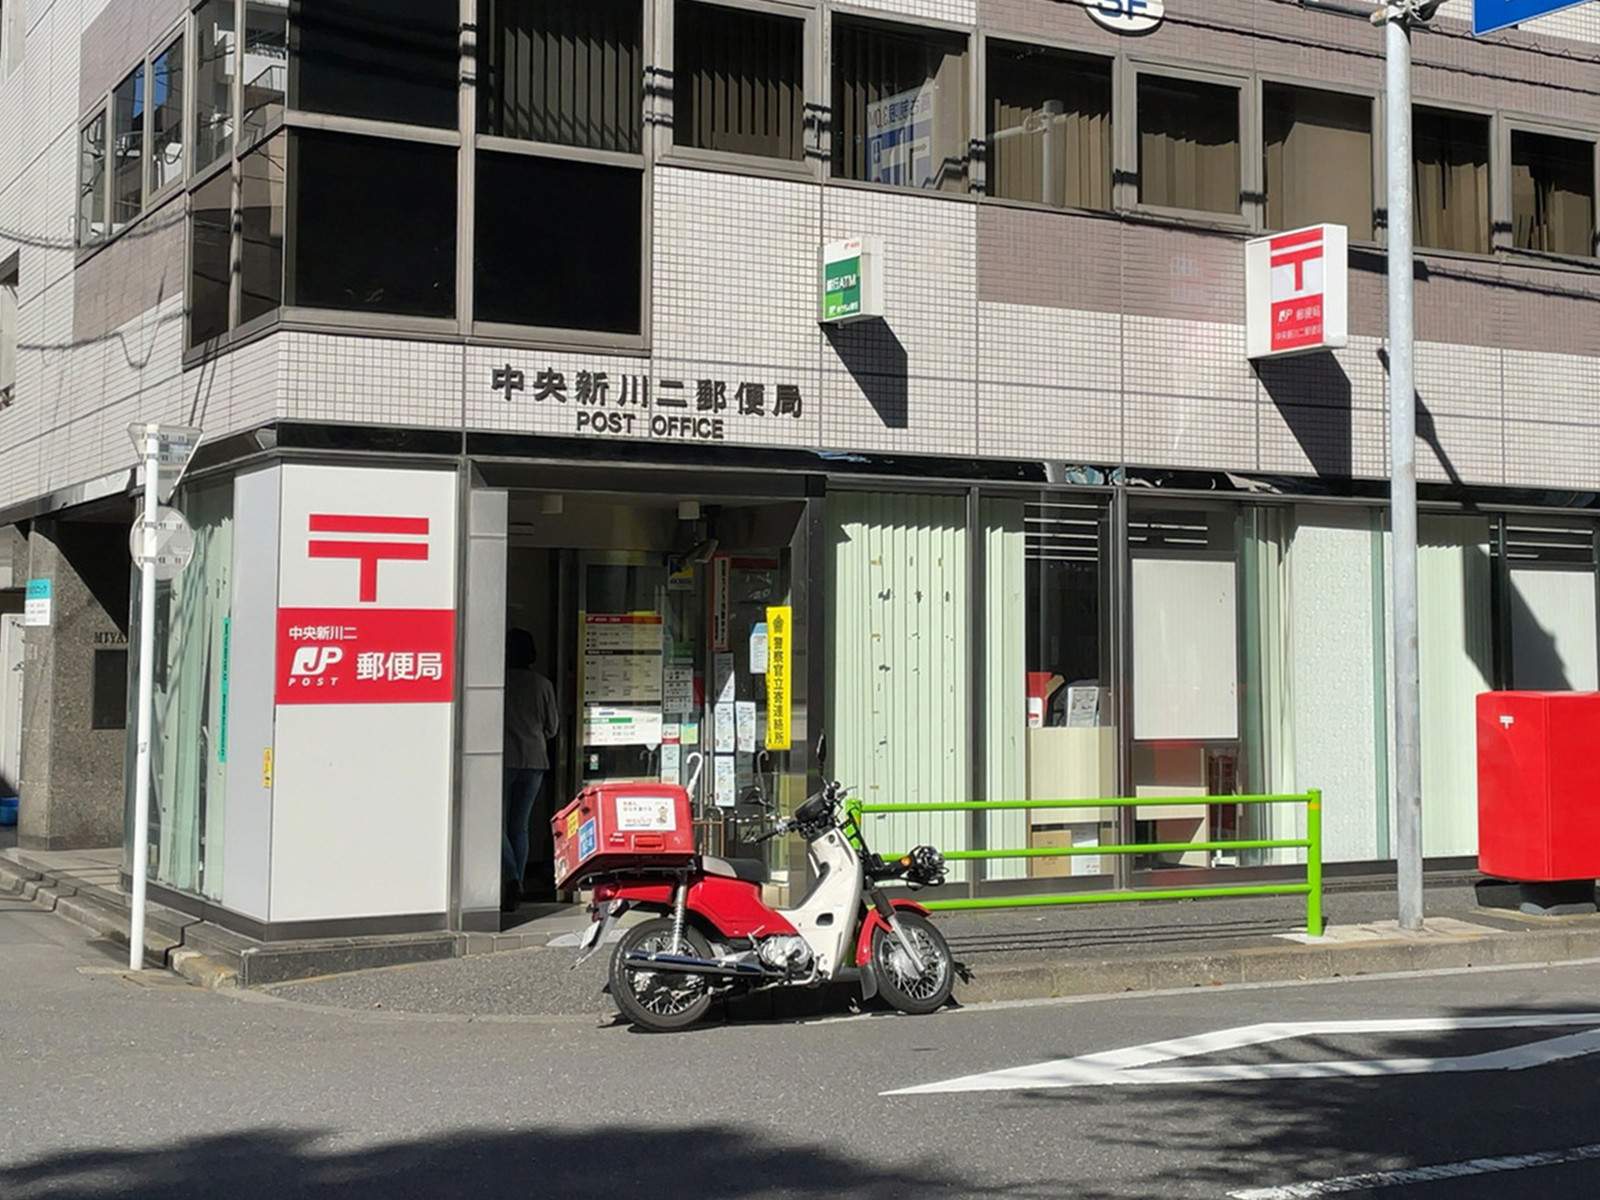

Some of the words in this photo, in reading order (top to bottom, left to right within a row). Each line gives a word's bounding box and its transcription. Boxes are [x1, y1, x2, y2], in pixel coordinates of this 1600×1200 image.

[491, 363, 803, 418] 中央新川二郵便局
[576, 411, 636, 434] POST
[651, 414, 724, 439] OFFICE
[93, 631, 129, 644] MIYA
[288, 625, 358, 641] 中央新川二
[290, 646, 344, 676] JP
[356, 652, 443, 682] 郵便局
[288, 677, 339, 687] POST
